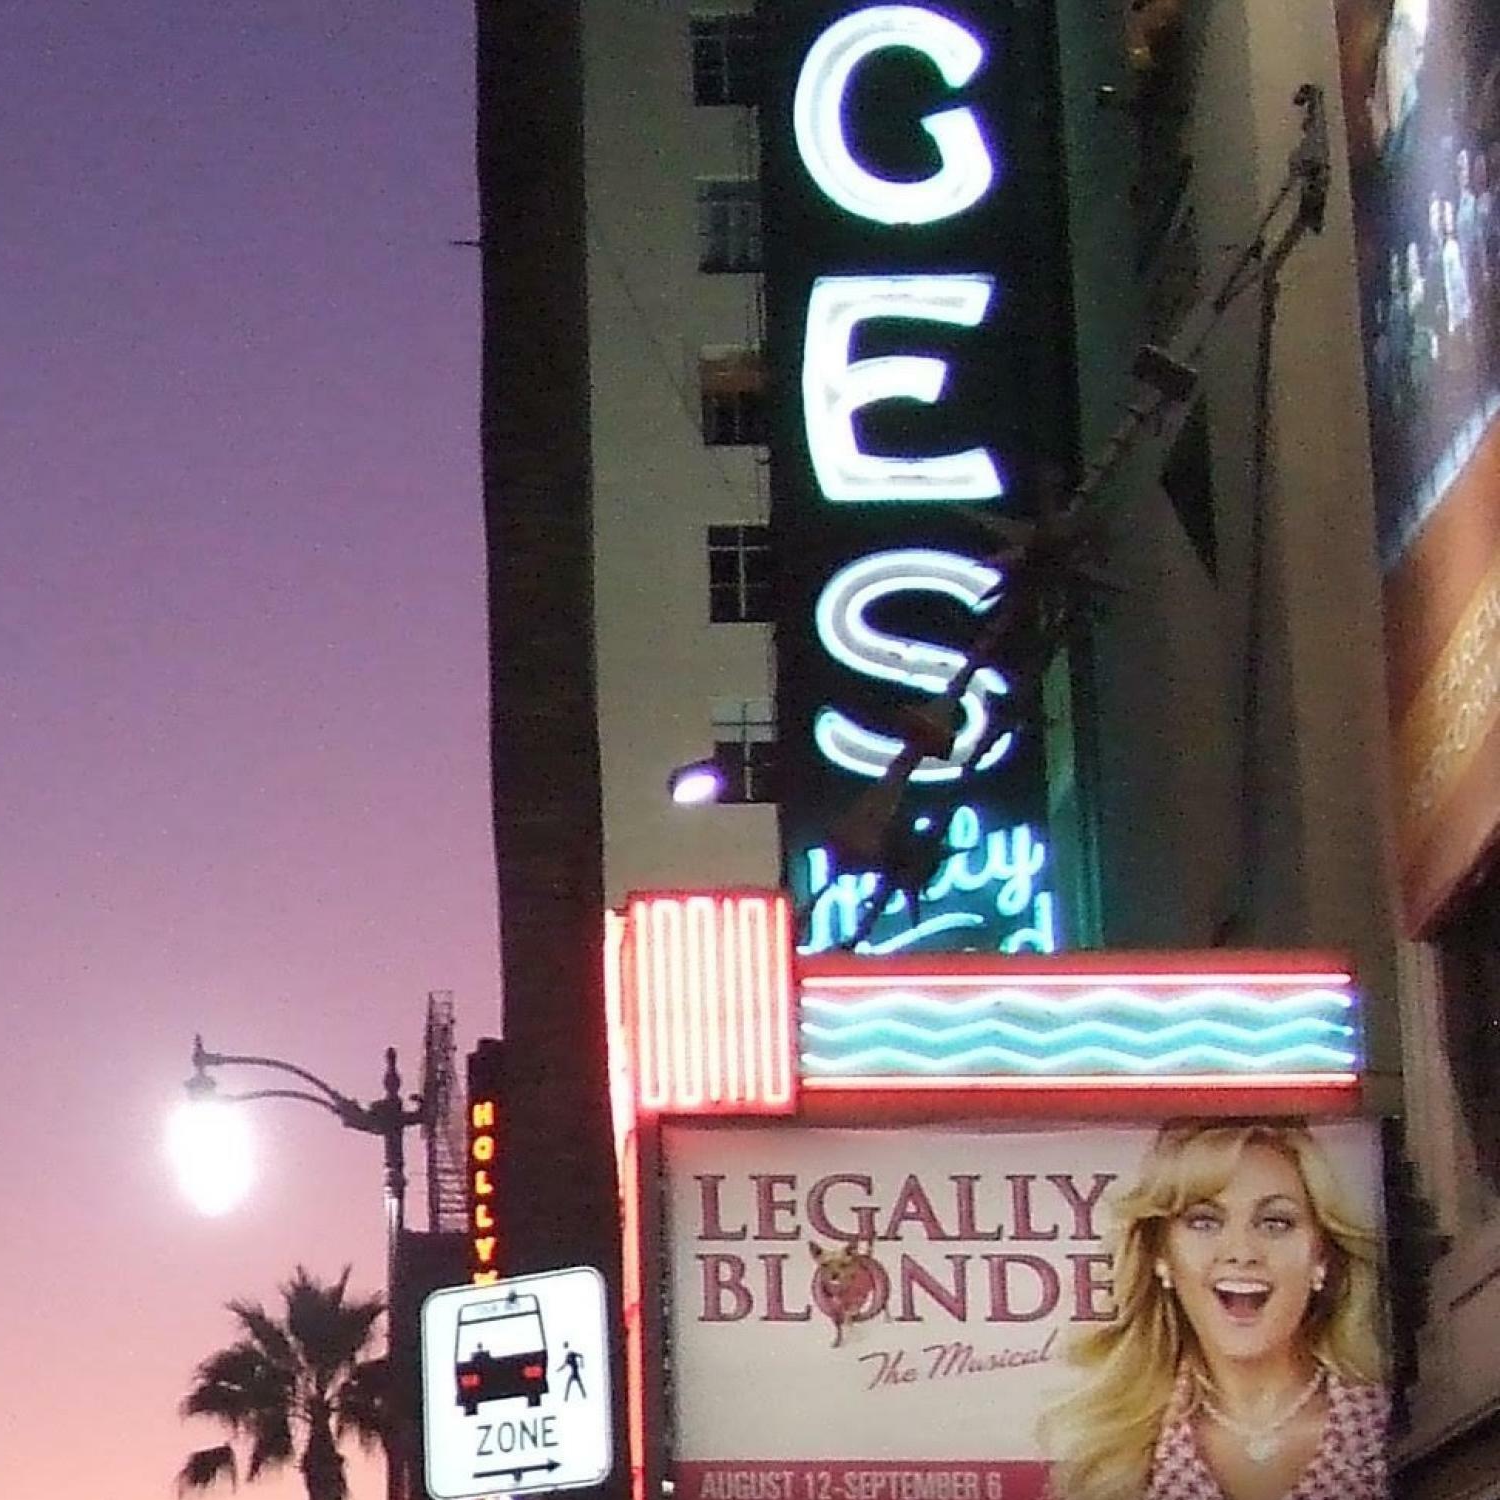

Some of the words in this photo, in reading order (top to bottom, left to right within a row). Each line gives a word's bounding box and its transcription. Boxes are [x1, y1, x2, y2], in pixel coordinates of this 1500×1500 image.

[693, 1173, 1119, 1241] LEGALLY
[694, 1252, 1120, 1323] BLONDE
[859, 1351, 918, 1390] The
[923, 1329, 1059, 1379] Musical
[476, 1416, 559, 1456] ZONE
[701, 1471, 793, 1500] AUGUST
[803, 1471, 980, 1500] 12-SEPTEMBER
[988, 1472, 1002, 1500] 6
